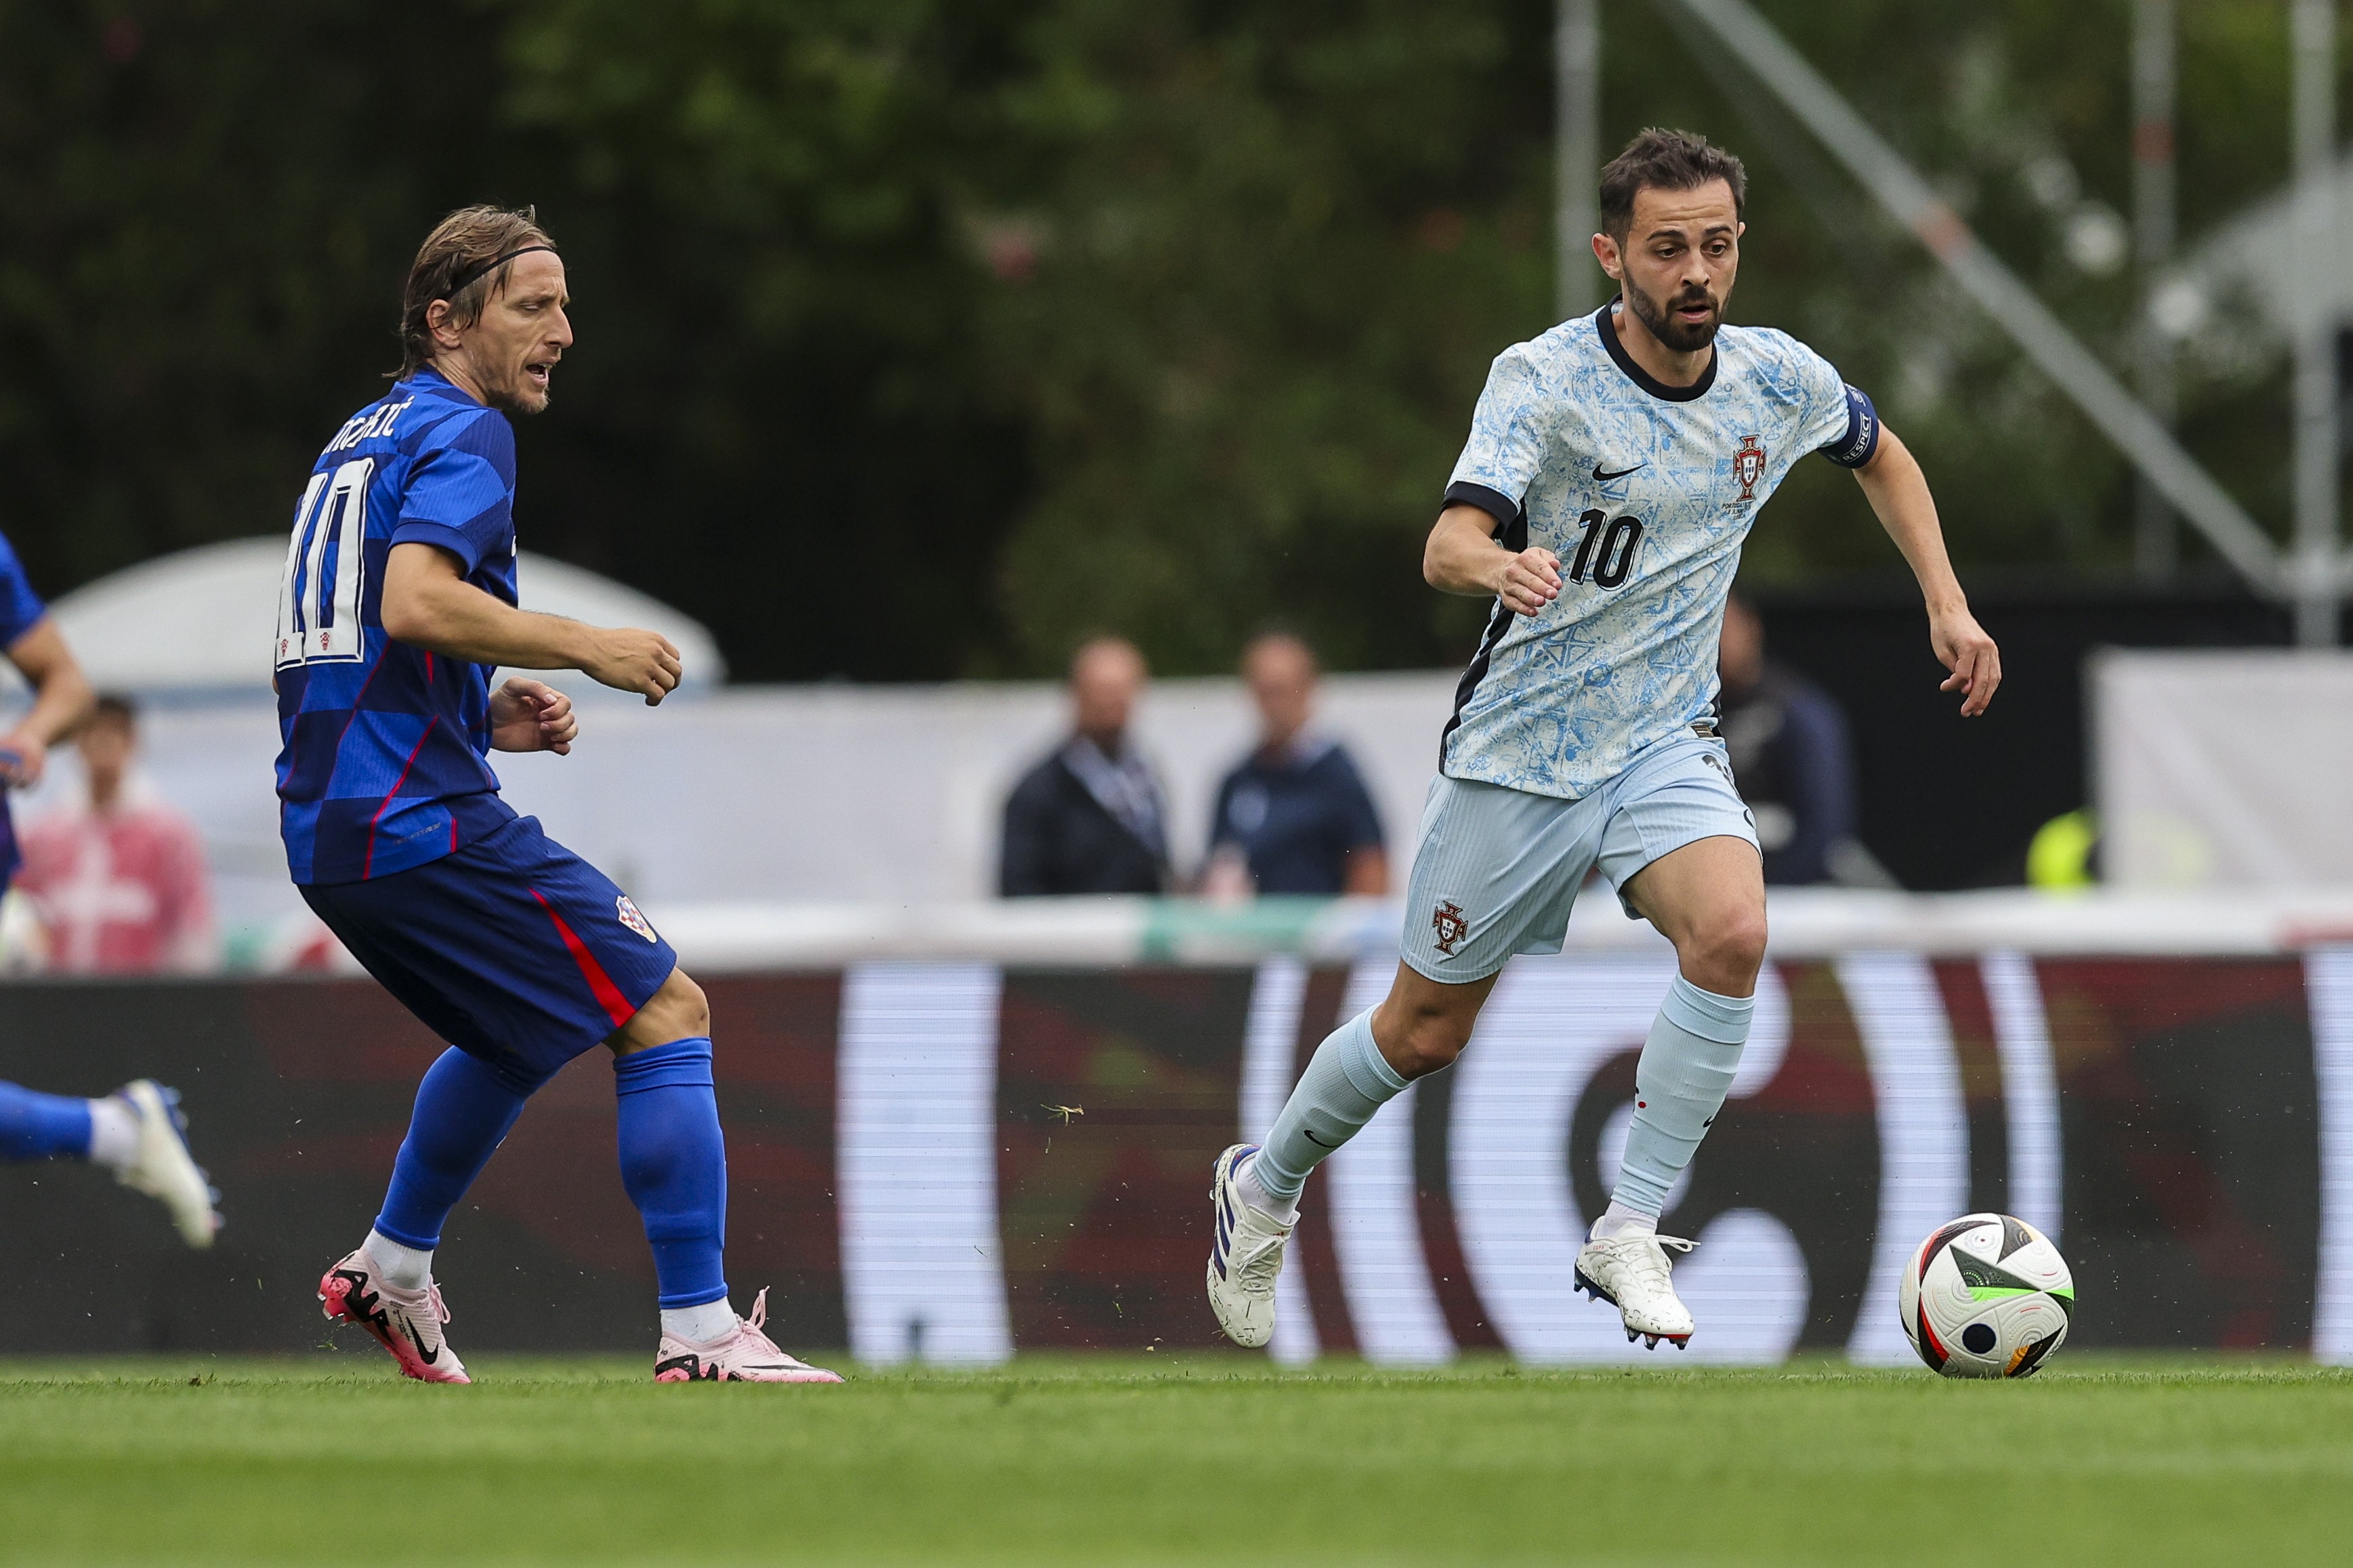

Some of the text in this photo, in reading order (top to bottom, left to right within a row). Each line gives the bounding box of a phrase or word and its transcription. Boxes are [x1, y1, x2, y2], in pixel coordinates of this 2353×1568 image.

[1843, 412, 1870, 461] RESPECT
[276, 457, 375, 672] 10
[1569, 508, 1644, 592] 10
